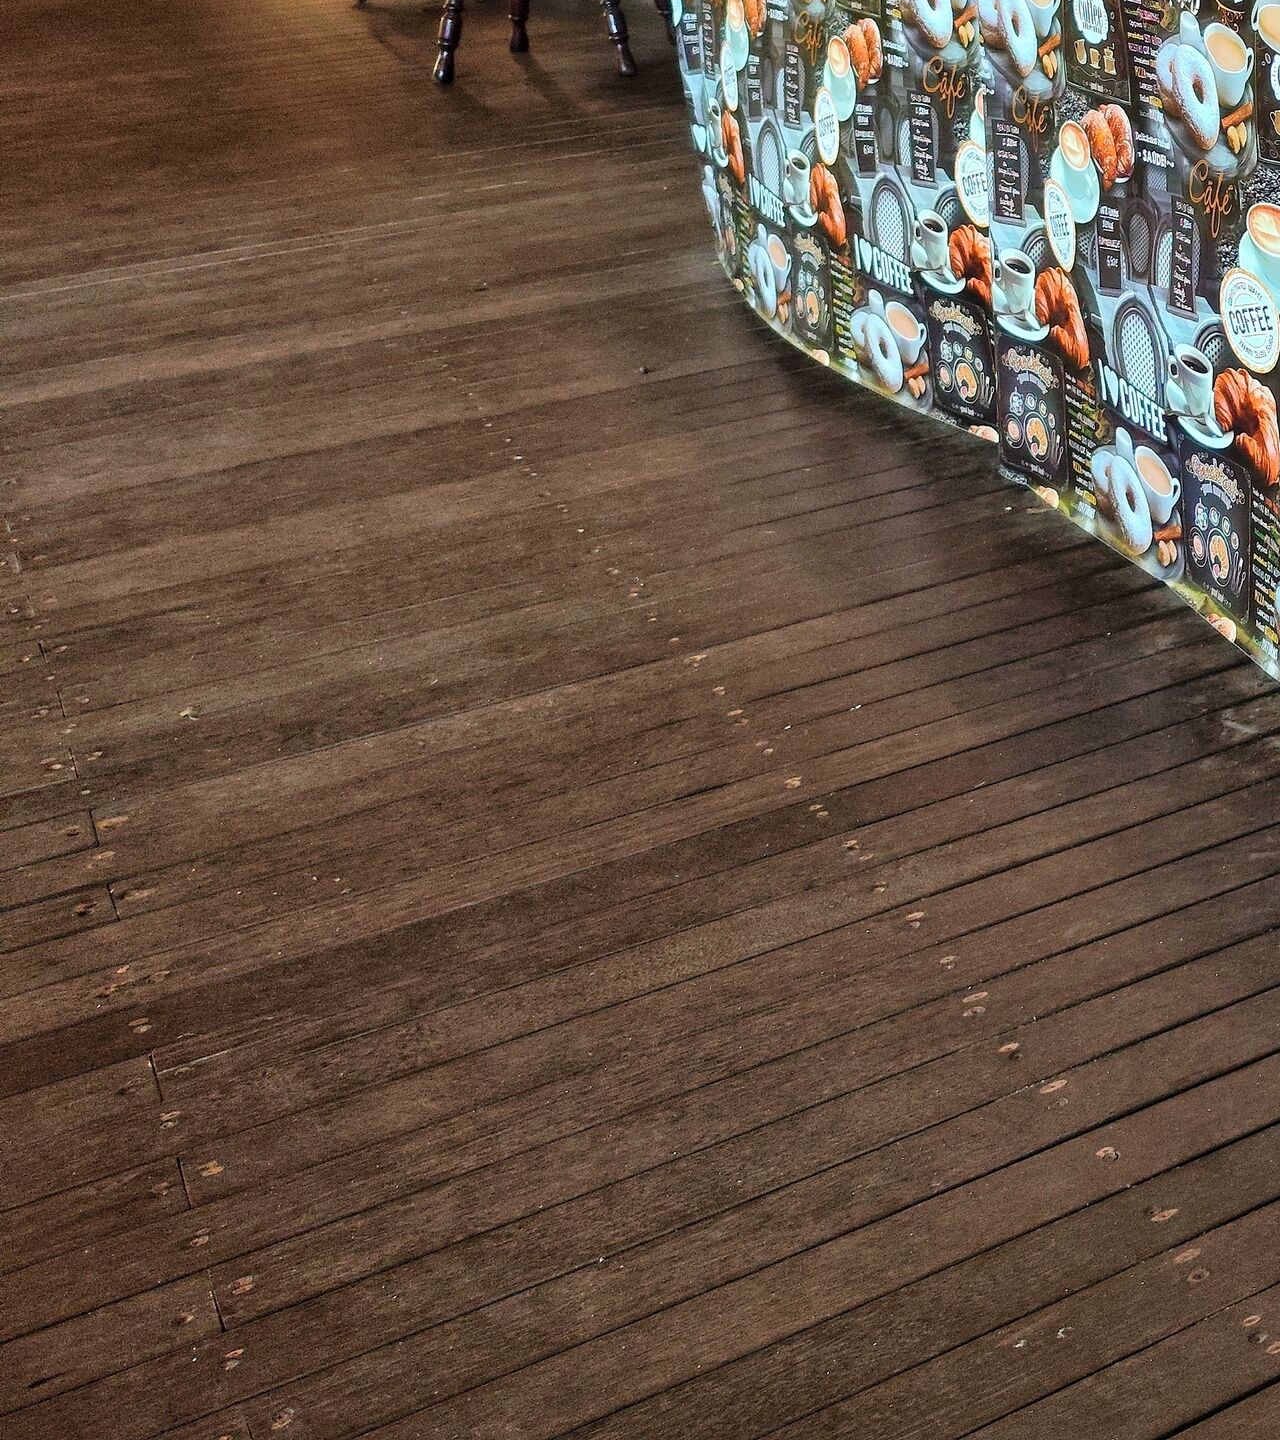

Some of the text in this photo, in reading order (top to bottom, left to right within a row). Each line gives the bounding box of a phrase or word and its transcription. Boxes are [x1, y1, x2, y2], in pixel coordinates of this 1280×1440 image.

[873, 246, 914, 295] COFFEE
[1229, 305, 1273, 335] COFFEE
[1120, 379, 1167, 443] COFFEE
